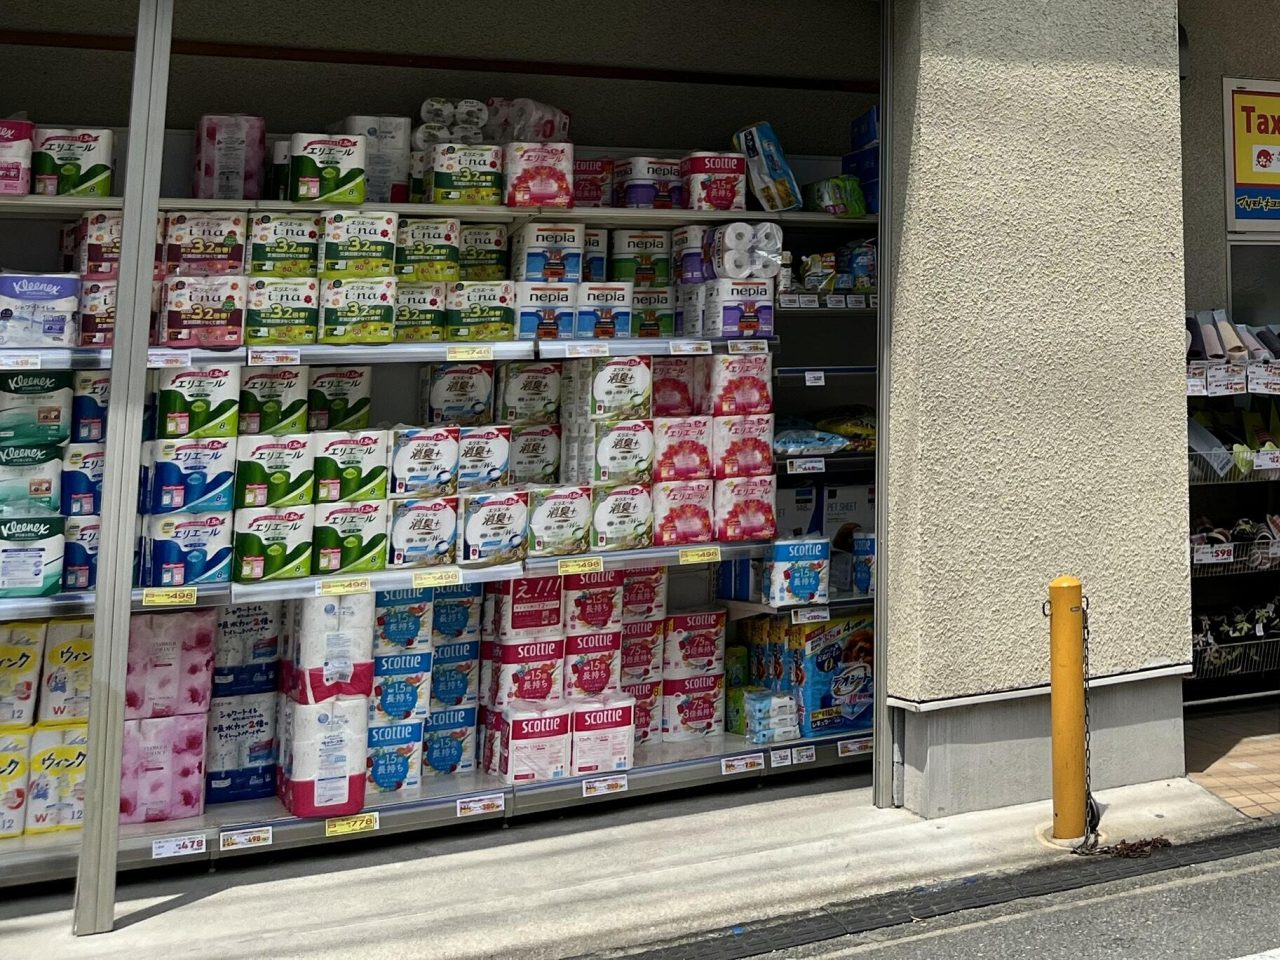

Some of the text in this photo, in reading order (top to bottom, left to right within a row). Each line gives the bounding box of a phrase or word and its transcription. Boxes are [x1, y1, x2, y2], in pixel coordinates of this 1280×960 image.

[44, 142, 95, 153] エリエール
[306, 146, 355, 158] エリエール
[704, 156, 738, 170] scottie
[646, 165, 681, 178] nepia
[535, 231, 576, 244] nepia
[626, 238, 665, 251] nepia
[12, 277, 62, 296] Kleenex
[730, 285, 768, 299] nepia
[528, 290, 570, 304] nepia
[586, 290, 626, 304] nepia
[8, 372, 55, 389] Kleenex
[176, 378, 225, 389] エリエール
[1, 521, 49, 537] Kleenex
[59, 645, 92, 664] ウィン
[517, 641, 555, 658] scottie
[381, 655, 421, 671] scottie
[11, 709, 24, 719] 12
[53, 706, 66, 716] W
[372, 726, 412, 742] scottie
[34, 813, 49, 824] W
